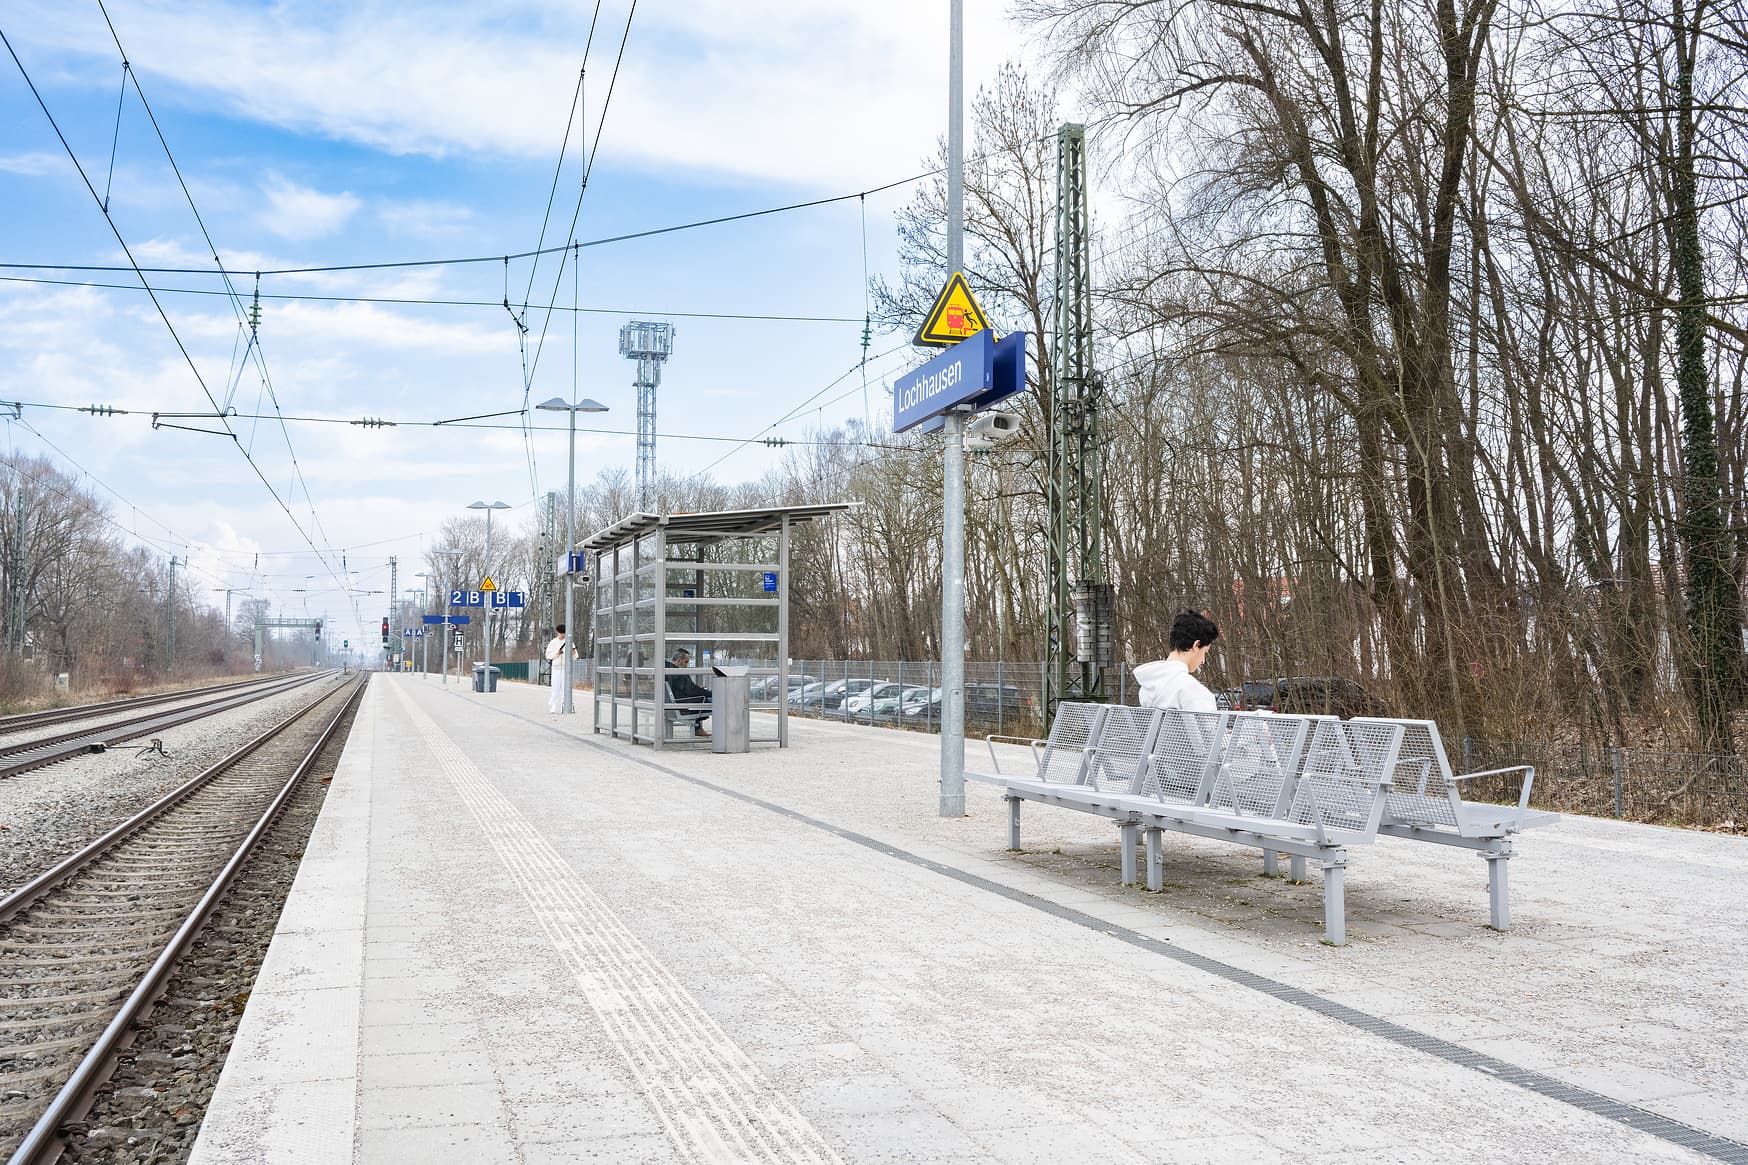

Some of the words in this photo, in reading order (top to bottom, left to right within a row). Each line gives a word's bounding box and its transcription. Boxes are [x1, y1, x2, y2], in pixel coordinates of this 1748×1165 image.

[898, 360, 962, 413] Lochhausen
[452, 591, 462, 604] 2
[470, 592, 480, 604] B
[496, 592, 506, 604] B
[517, 592, 524, 604] 1
[456, 636, 462, 645] H
